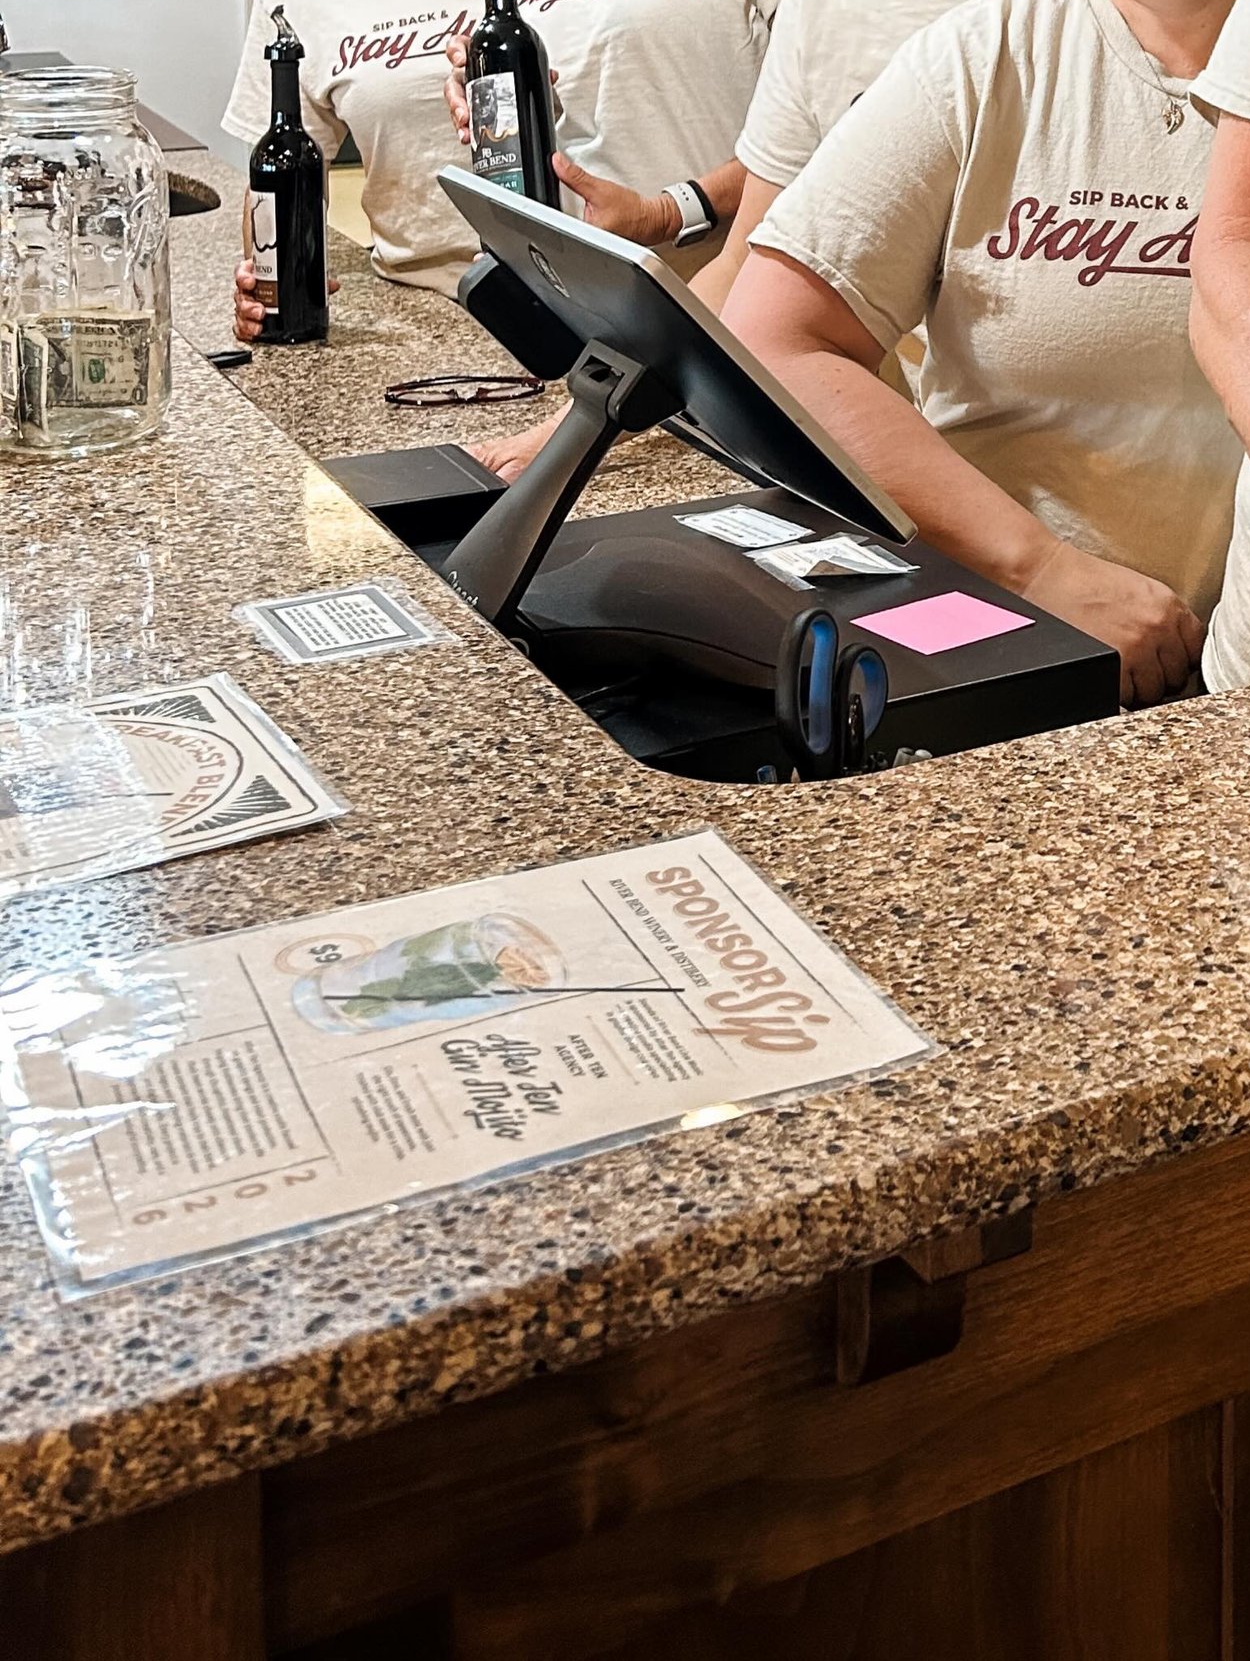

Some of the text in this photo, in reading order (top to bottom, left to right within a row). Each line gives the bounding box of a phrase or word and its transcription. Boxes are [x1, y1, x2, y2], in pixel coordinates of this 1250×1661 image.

[373, 22, 394, 33] SIP
[399, 12, 436, 28] BACK
[332, 31, 418, 77] Stay
[1069, 190, 1189, 210] SIP BACK &
[987, 196, 1138, 287] Stay
[609, 878, 635, 898] RIVER
[627, 898, 649, 917] BEND
[643, 916, 673, 944] WINERY
[664, 944, 677, 952] &
[645, 866, 786, 992] SPONSOR
[309, 942, 342, 964] $9
[486, 1034, 563, 1115] After Ten
[555, 1045, 586, 1078] AGENCY
[569, 1034, 608, 1078] AFTER TEN
[441, 1038, 527, 1139] Gin Mojito
